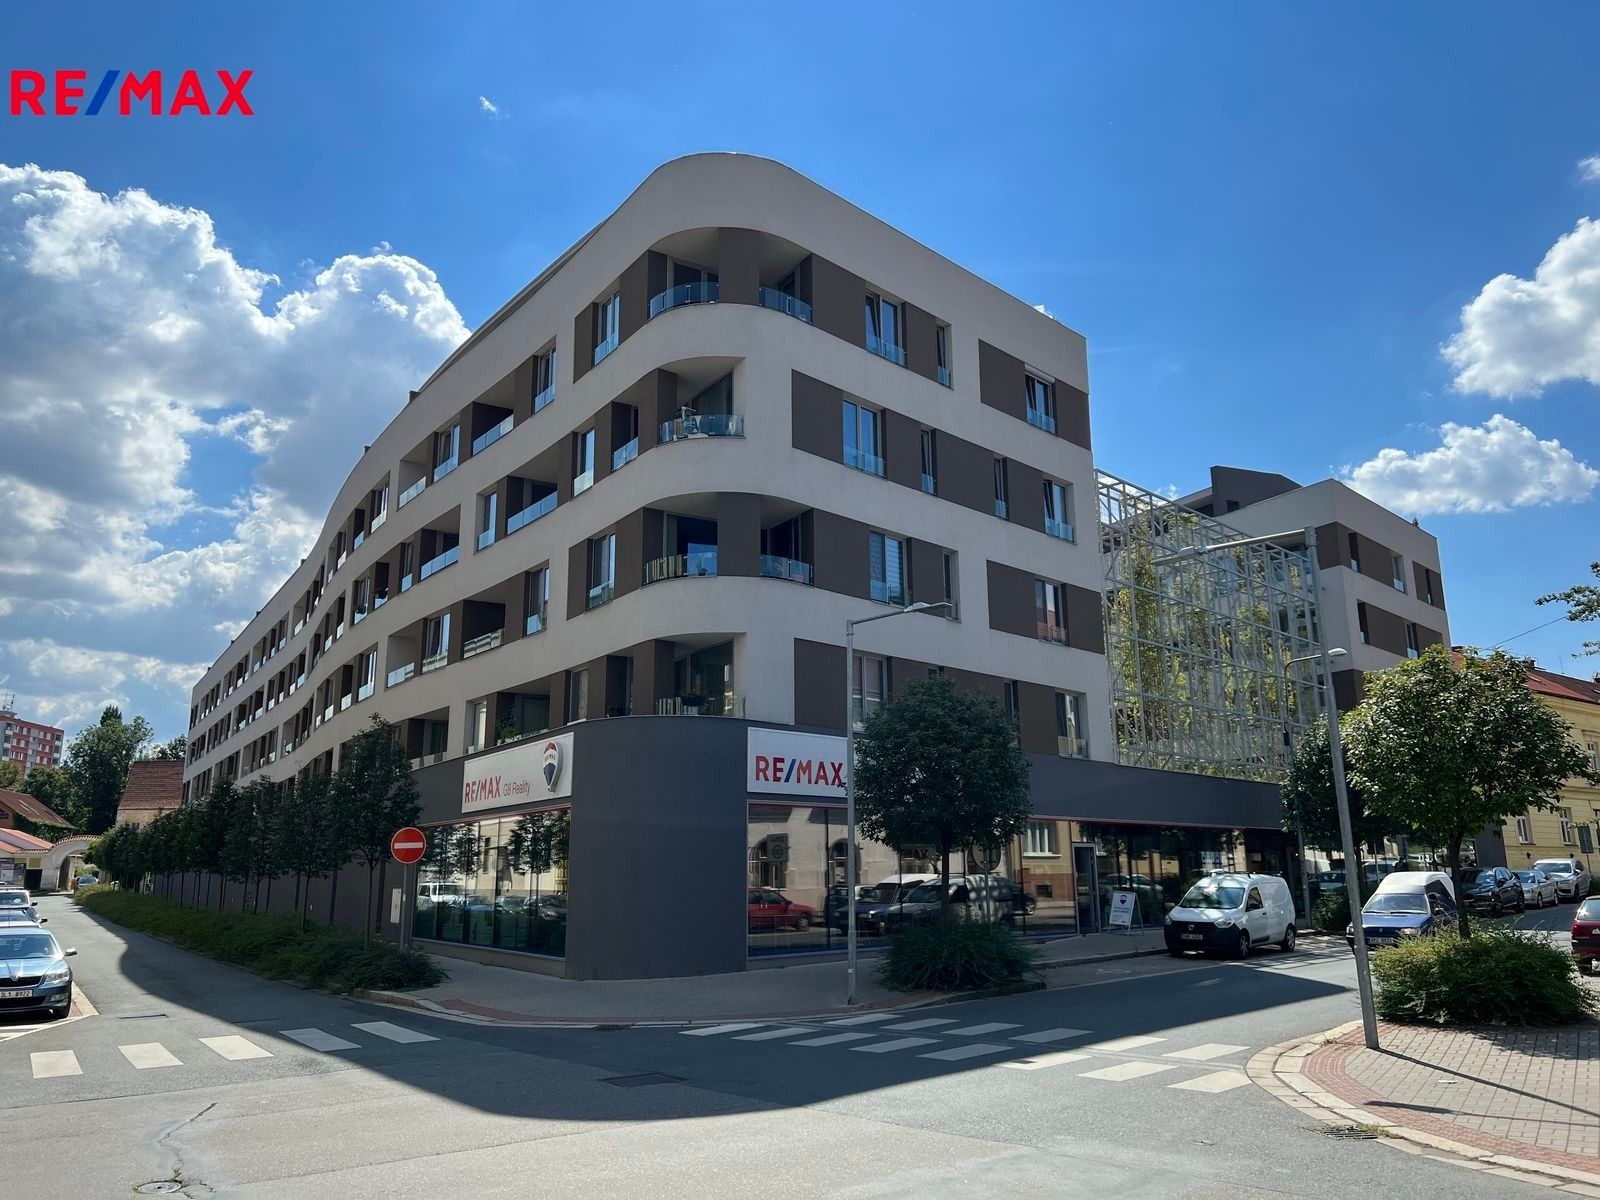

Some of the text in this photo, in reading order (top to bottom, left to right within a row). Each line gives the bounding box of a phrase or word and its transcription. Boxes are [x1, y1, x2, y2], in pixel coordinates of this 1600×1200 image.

[755, 755, 843, 786] RE/MAX
[464, 775, 501, 804] RE/MAX
[512, 780, 531, 796] Reality
